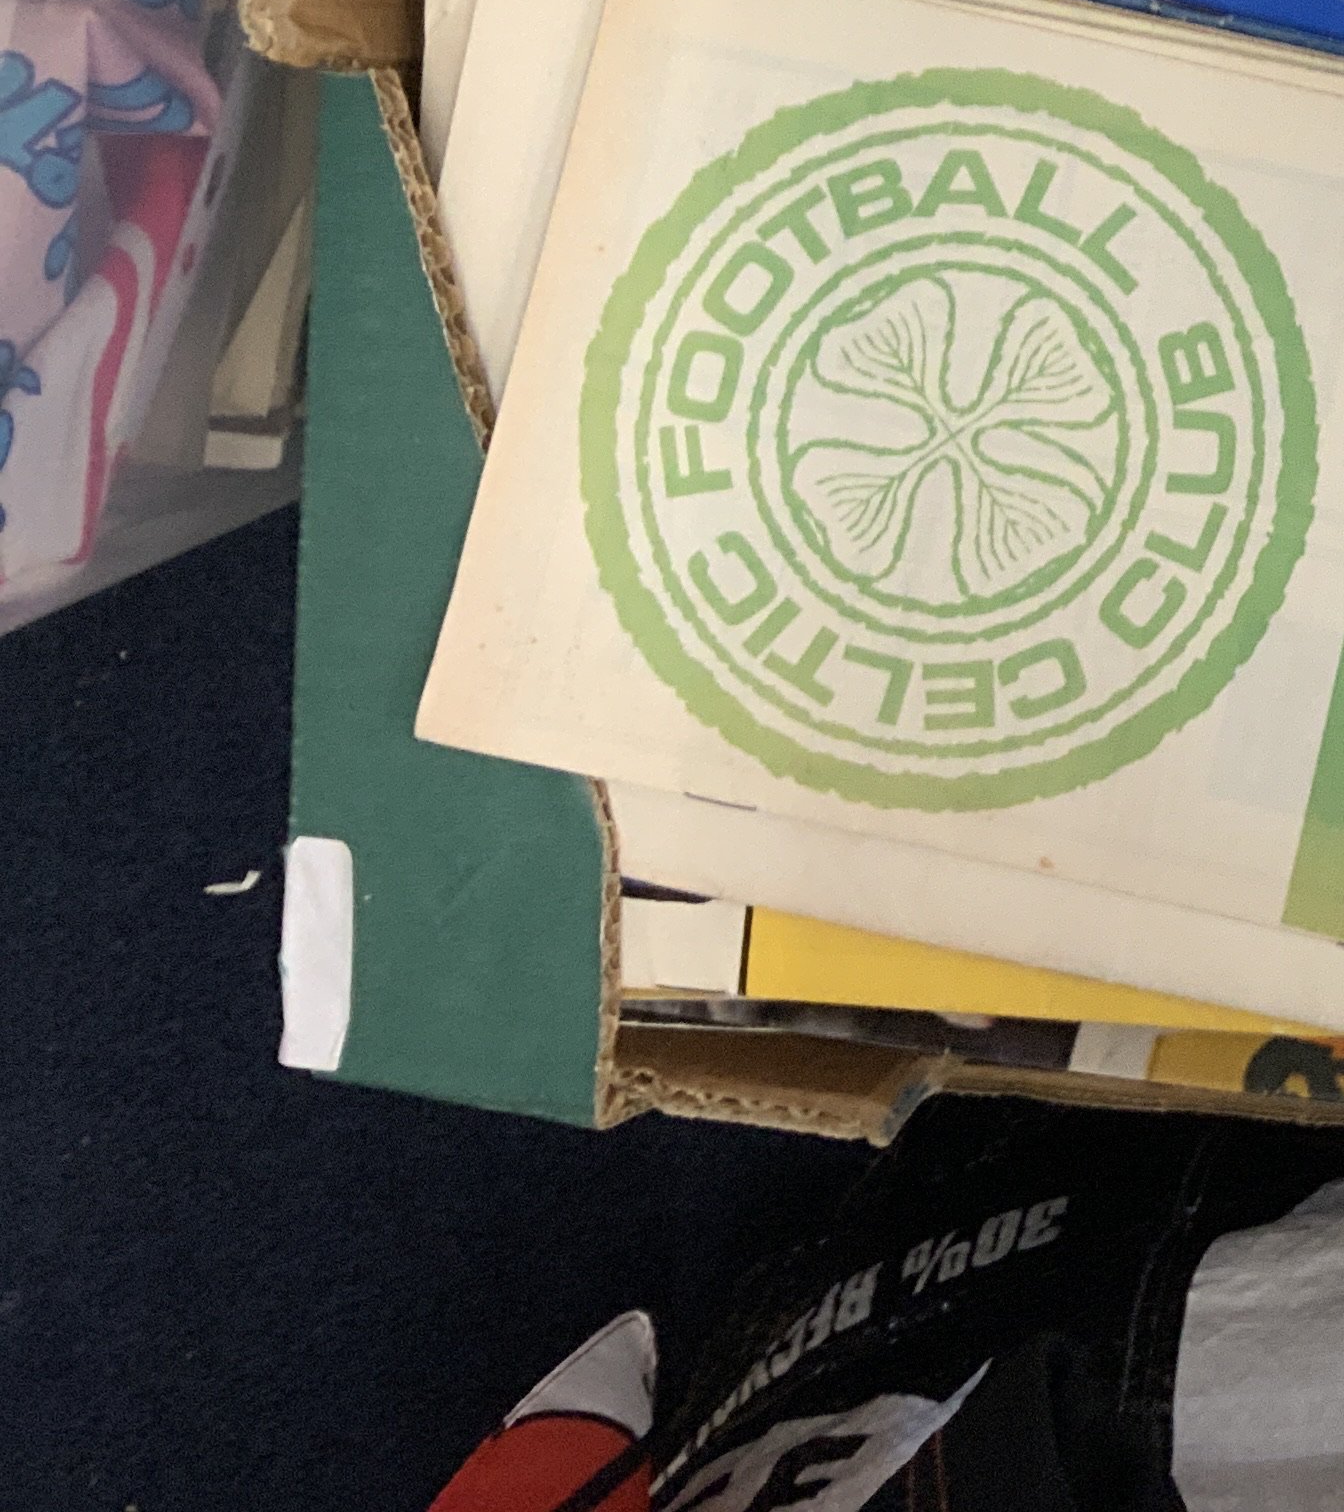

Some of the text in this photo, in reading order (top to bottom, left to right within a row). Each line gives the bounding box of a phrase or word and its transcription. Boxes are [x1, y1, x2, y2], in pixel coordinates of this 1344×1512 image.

[659, 148, 1139, 499] FOOTBALL
[1099, 320, 1239, 651] CLUB
[688, 529, 1087, 731] CELTIC
[901, 1194, 1069, 1299] 30%
